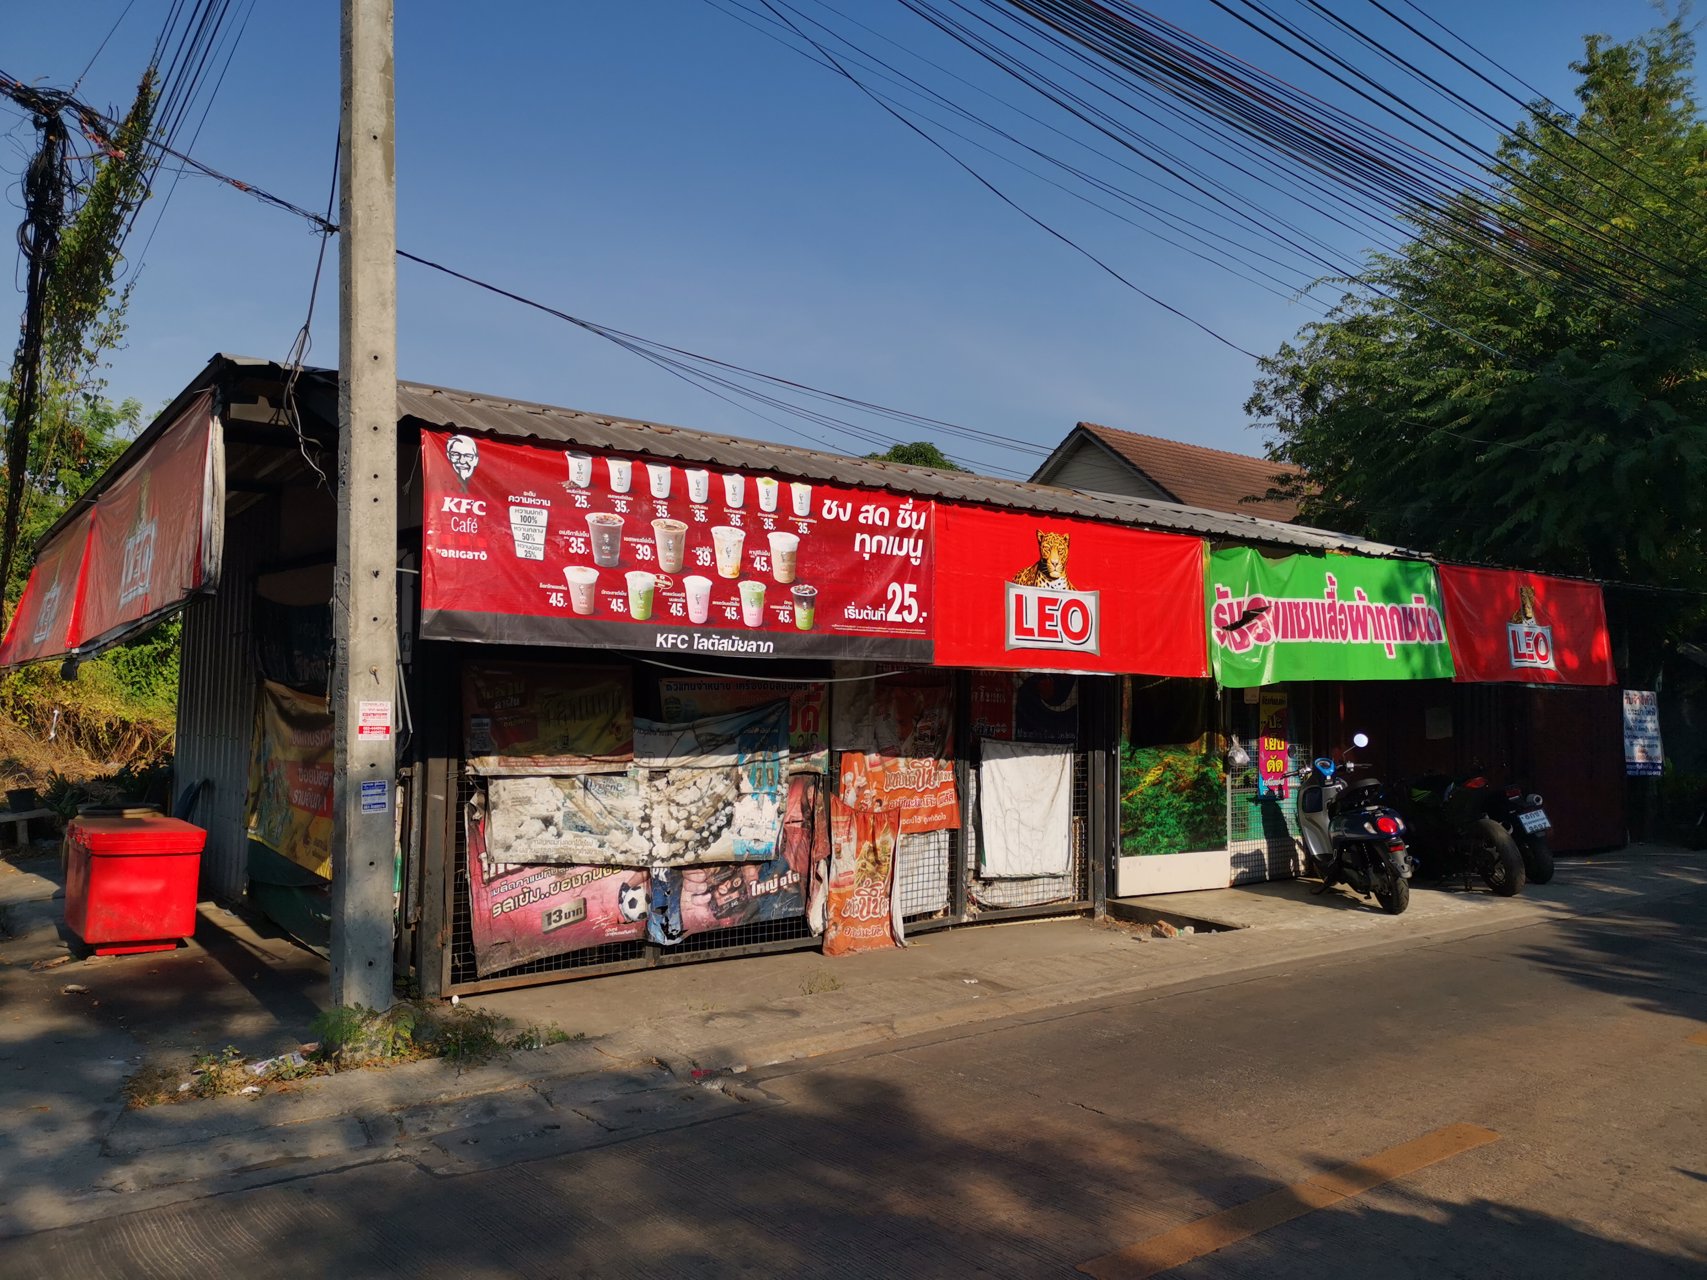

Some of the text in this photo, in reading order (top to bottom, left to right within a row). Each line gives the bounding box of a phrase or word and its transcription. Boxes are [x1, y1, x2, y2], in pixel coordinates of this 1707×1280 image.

[441, 497, 487, 516] KFC
[508, 495, 551, 507] ความหวาน
[520, 515, 537, 525] 100%
[821, 497, 926, 530] ชง สด ชื่น
[451, 516, 478, 533] Café
[521, 533, 536, 542] 50%
[854, 532, 924, 566] ทุกเมนู
[844, 602, 886, 621] เริ่มต้นที่
[1014, 593, 1093, 645] LEO
[656, 633, 774, 653] KFC โลตัสมัยลาภ
[1510, 629, 1550, 664] LEO
[545, 907, 583, 927] 13 บาท
